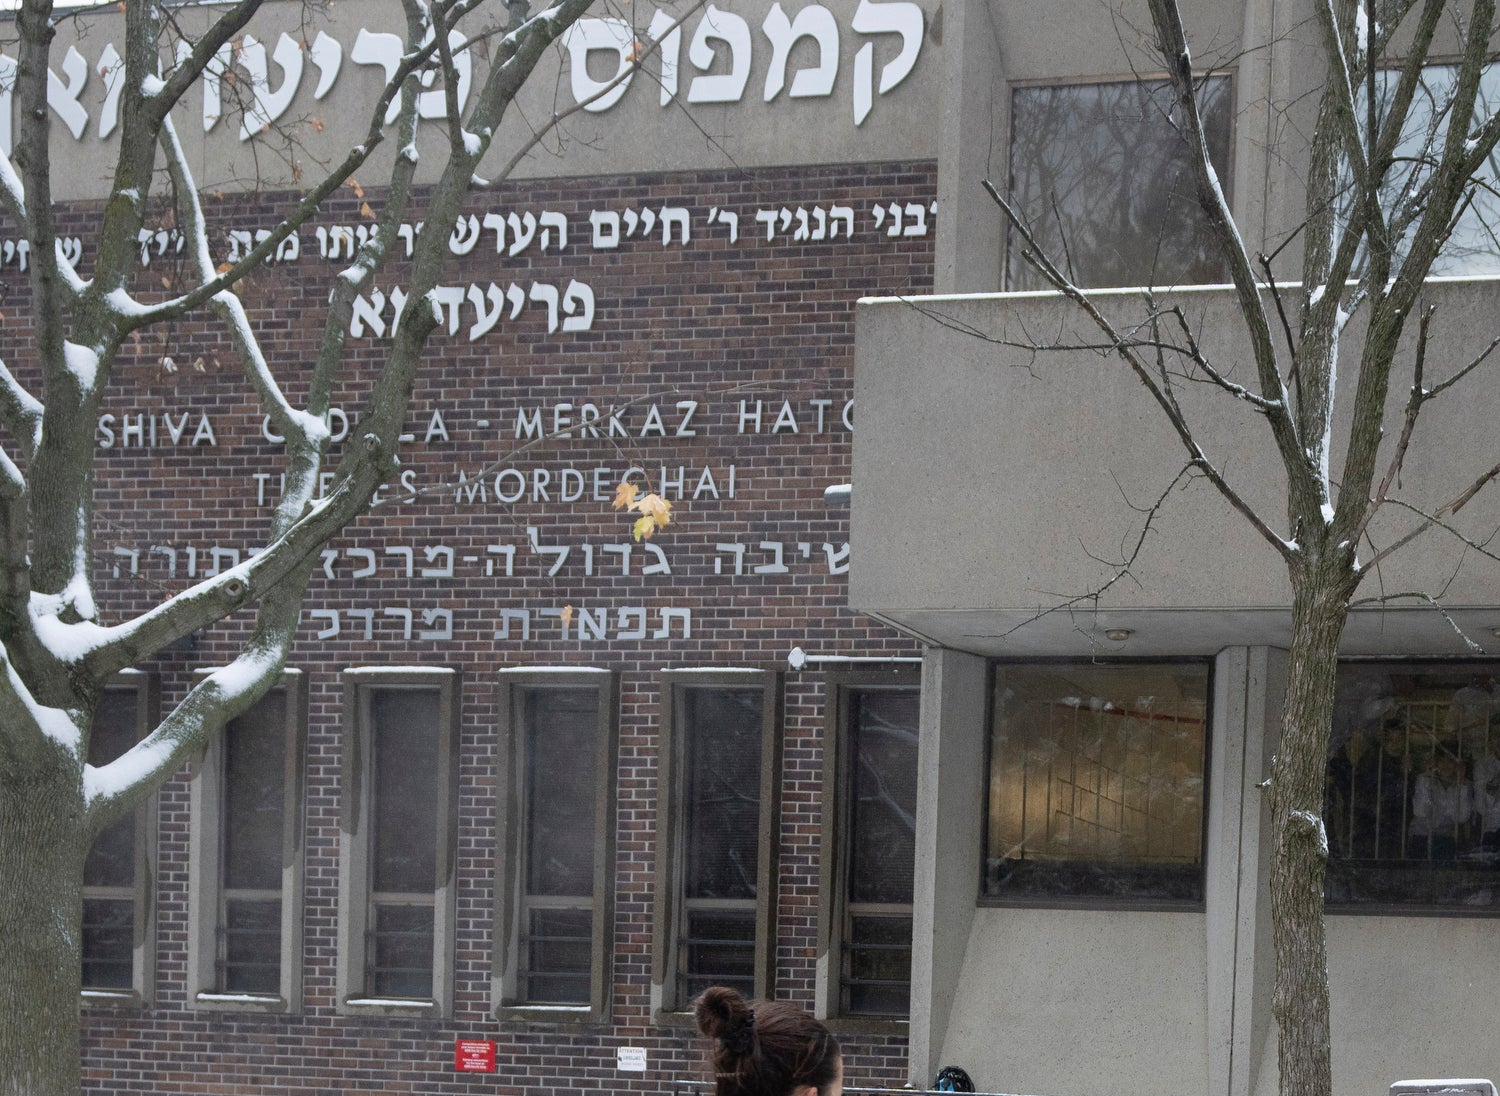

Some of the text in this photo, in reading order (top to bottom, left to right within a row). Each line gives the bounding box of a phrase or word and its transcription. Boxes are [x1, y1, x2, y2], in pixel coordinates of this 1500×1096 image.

[562, 0, 925, 127] קמפוס
[449, 210, 568, 258] הערש
[590, 205, 691, 250] חיים
[756, 204, 855, 243] הנגיד
[329, 278, 595, 343] פריעדא
[515, 400, 697, 440] MERKAZ
[456, 464, 735, 505] MORDECHAI
[715, 540, 850, 577] שיבה
[493, 606, 692, 641] תפארת
